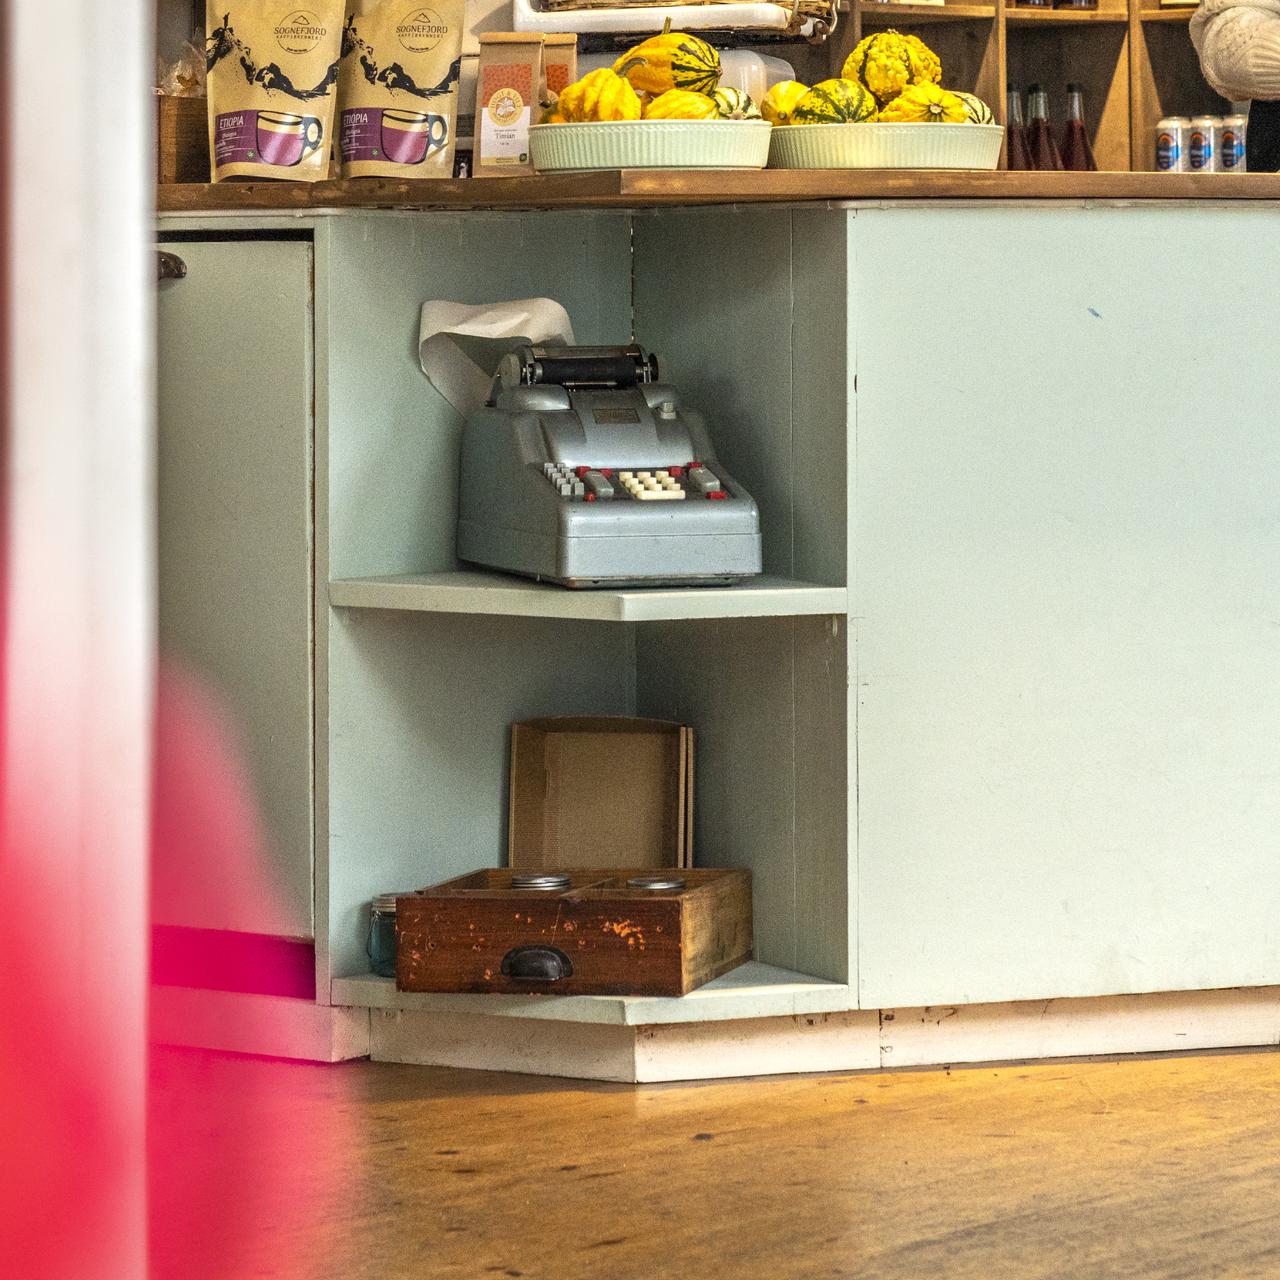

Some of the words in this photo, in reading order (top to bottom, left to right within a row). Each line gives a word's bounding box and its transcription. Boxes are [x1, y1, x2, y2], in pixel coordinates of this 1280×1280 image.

[274, 26, 327, 37] SOGNEFJORD
[395, 24, 448, 34] SOGNEFJORD
[219, 115, 245, 129] ETIOPIA
[343, 113, 368, 127] ETIOPIA
